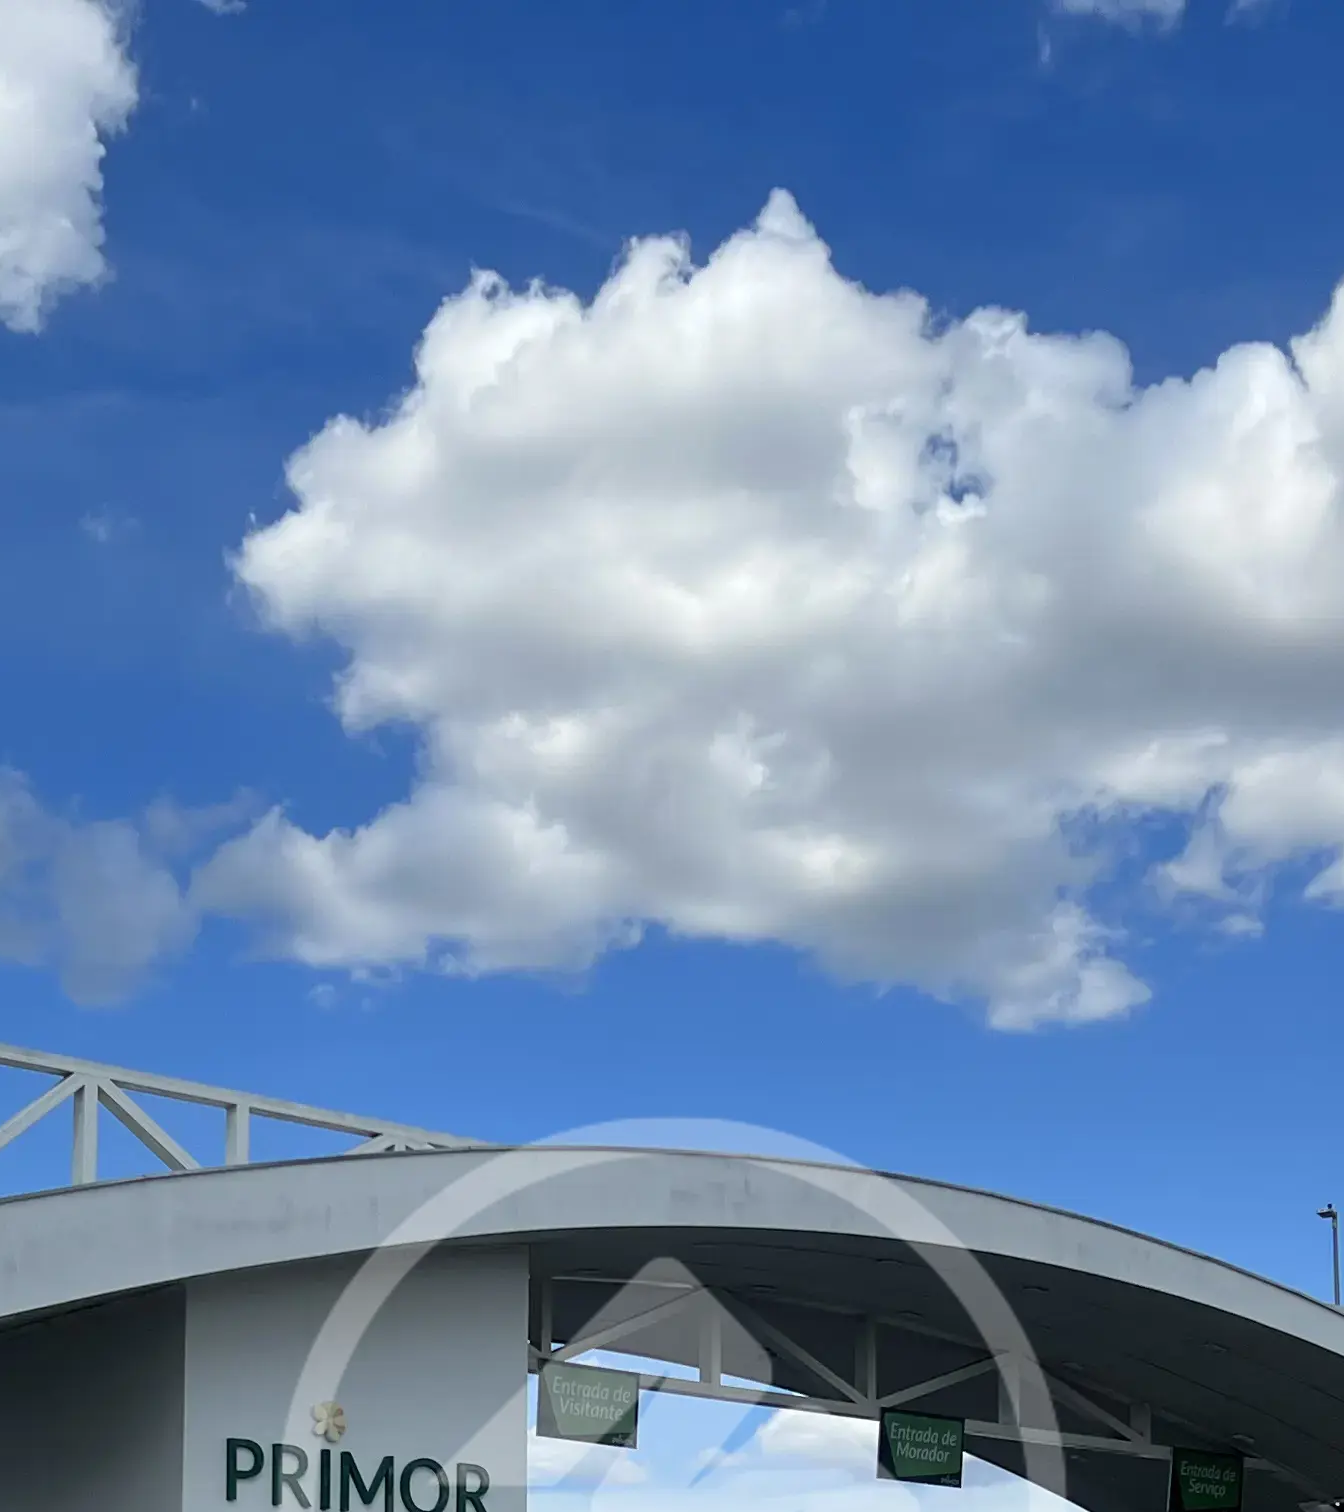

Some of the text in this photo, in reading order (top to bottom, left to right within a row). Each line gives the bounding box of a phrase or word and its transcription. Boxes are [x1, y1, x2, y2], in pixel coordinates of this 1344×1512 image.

[552, 1376, 631, 1403] Entrada de
[560, 1395, 623, 1421] Visitante
[890, 1422, 957, 1446] Entrada de
[896, 1441, 950, 1463] Morador
[1180, 1460, 1236, 1482] Entrada de
[1188, 1478, 1226, 1499] Serviço
